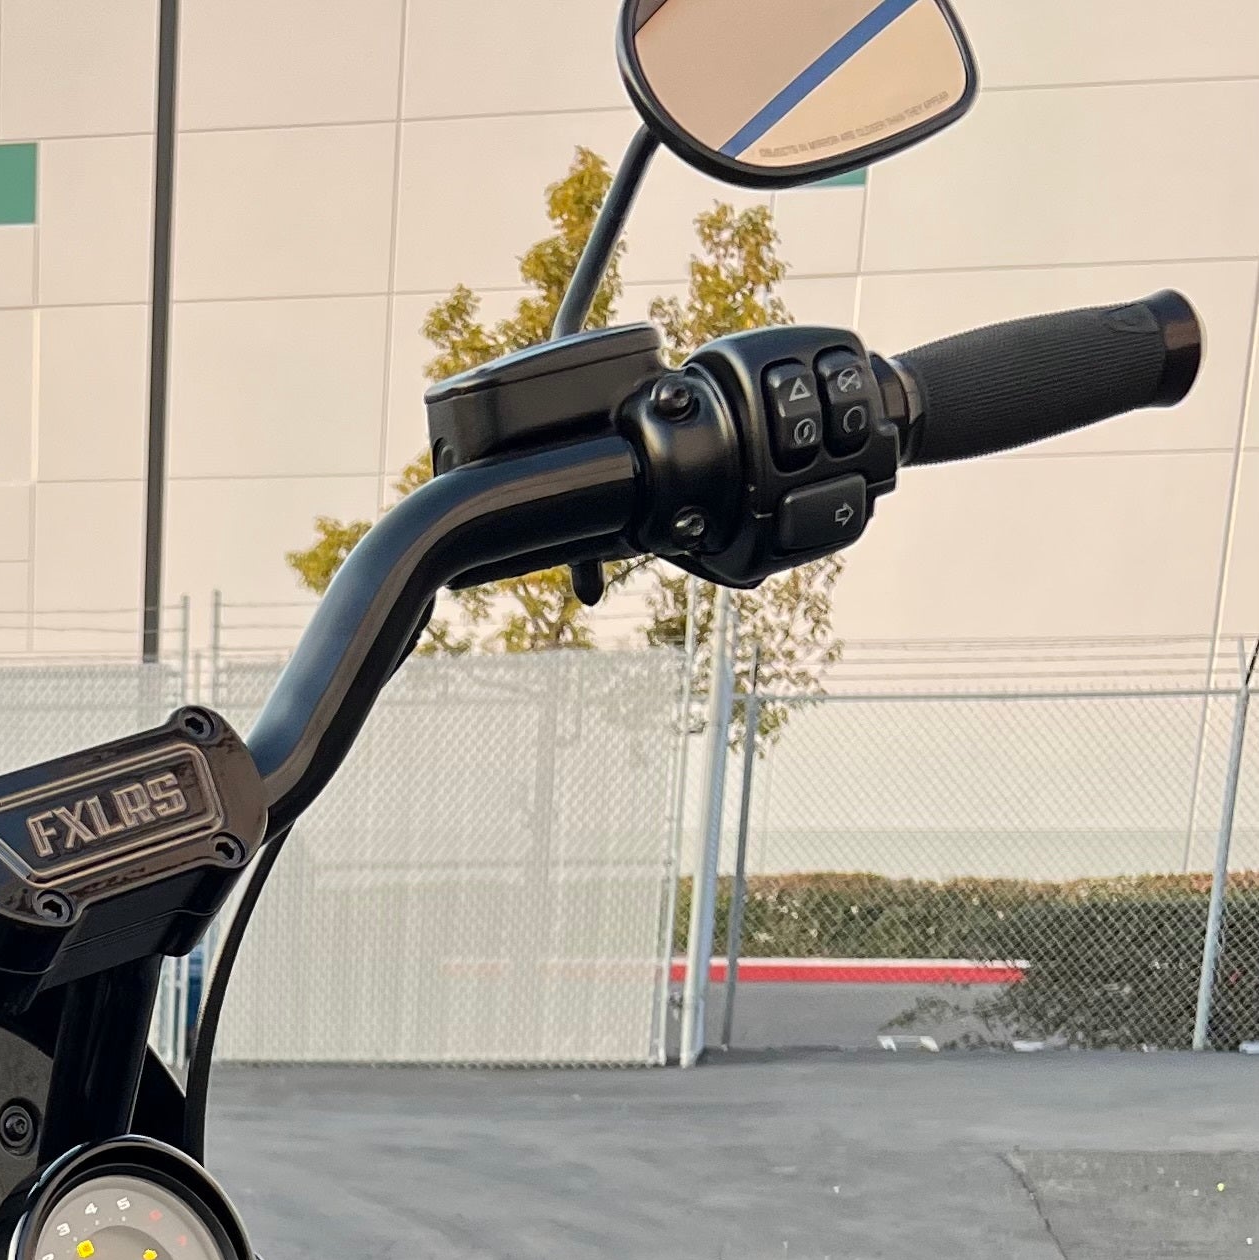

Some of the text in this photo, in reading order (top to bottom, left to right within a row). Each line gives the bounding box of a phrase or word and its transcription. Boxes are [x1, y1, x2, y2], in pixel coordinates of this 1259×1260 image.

[26, 772, 188, 858] FXLRS
[84, 1202, 99, 1216] 4
[116, 1196, 131, 1211] 5
[56, 1222, 71, 1237] 3
